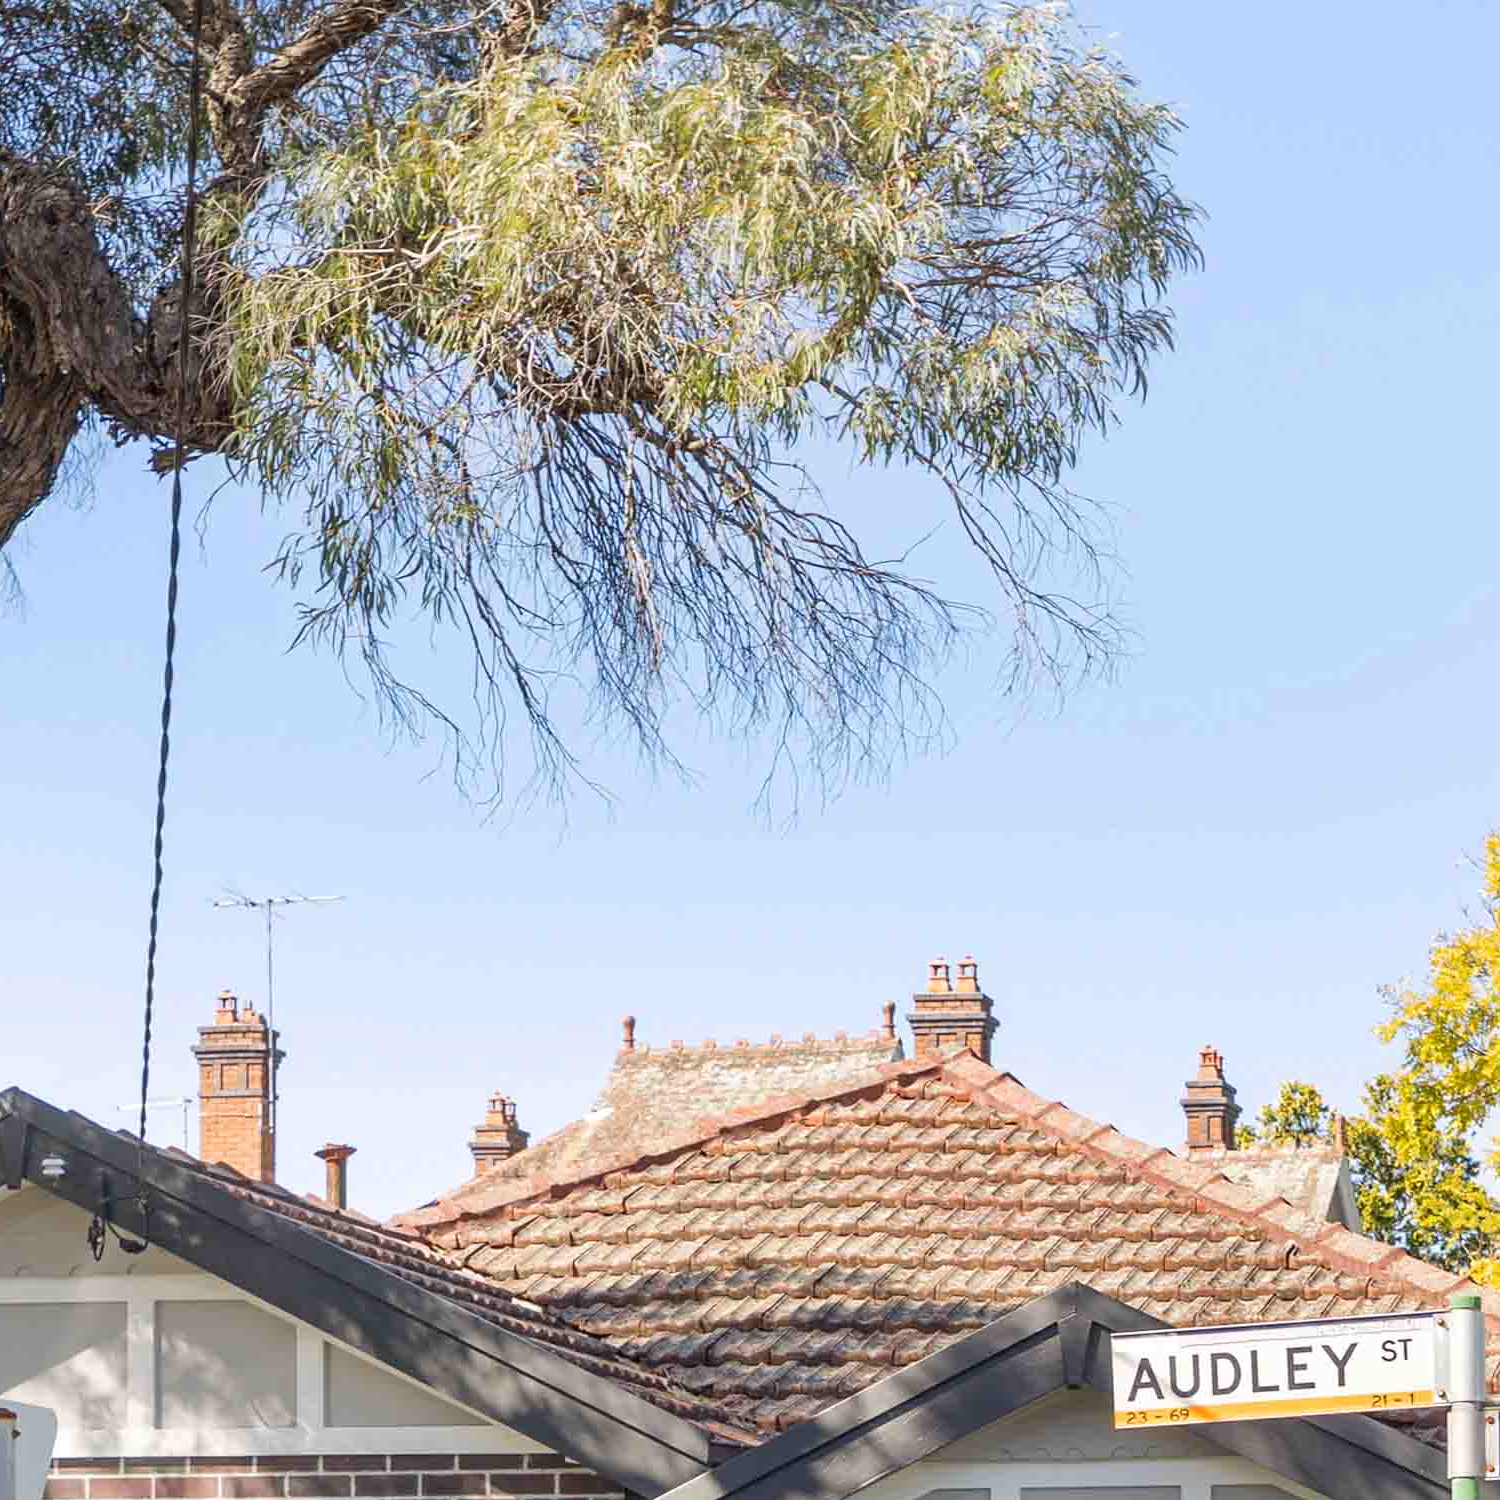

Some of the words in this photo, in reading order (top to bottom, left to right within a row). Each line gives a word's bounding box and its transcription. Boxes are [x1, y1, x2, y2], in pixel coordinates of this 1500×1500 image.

[1127, 1342, 1358, 1402] AUDLEY
[1381, 1338, 1413, 1362] ST
[1372, 1394, 1388, 1408] 21
[1126, 1410, 1148, 1425] 23
[1169, 1408, 1190, 1422] 69
